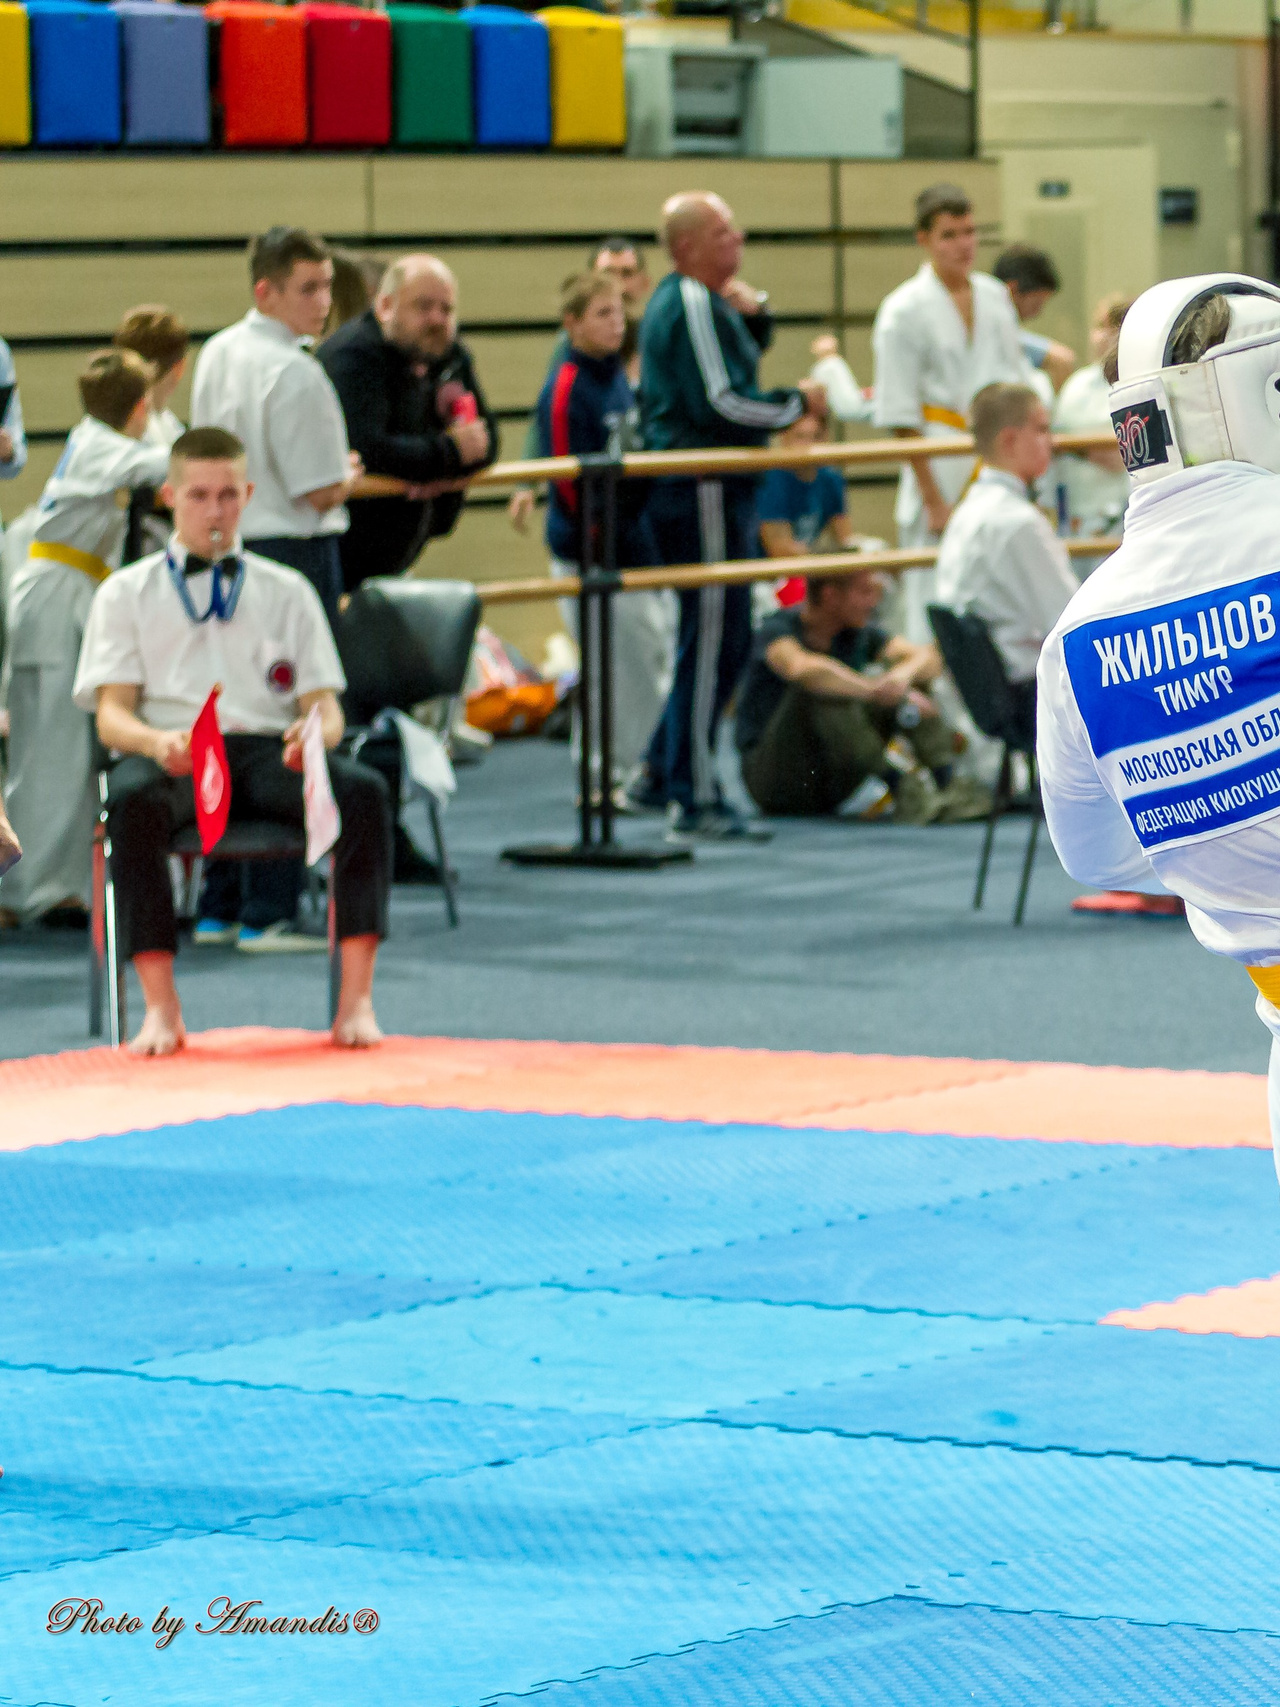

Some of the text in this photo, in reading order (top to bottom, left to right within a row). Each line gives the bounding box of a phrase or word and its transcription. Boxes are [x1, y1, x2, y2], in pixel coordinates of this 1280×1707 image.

[1093, 593, 1276, 687] ЖИЛЬЦОВ
[1154, 665, 1233, 716] ТИМУР
[1119, 728, 1242, 786] МОСКОВСКАЯ
[1136, 797, 1210, 835] ФЕДЕРАЦИЯ
